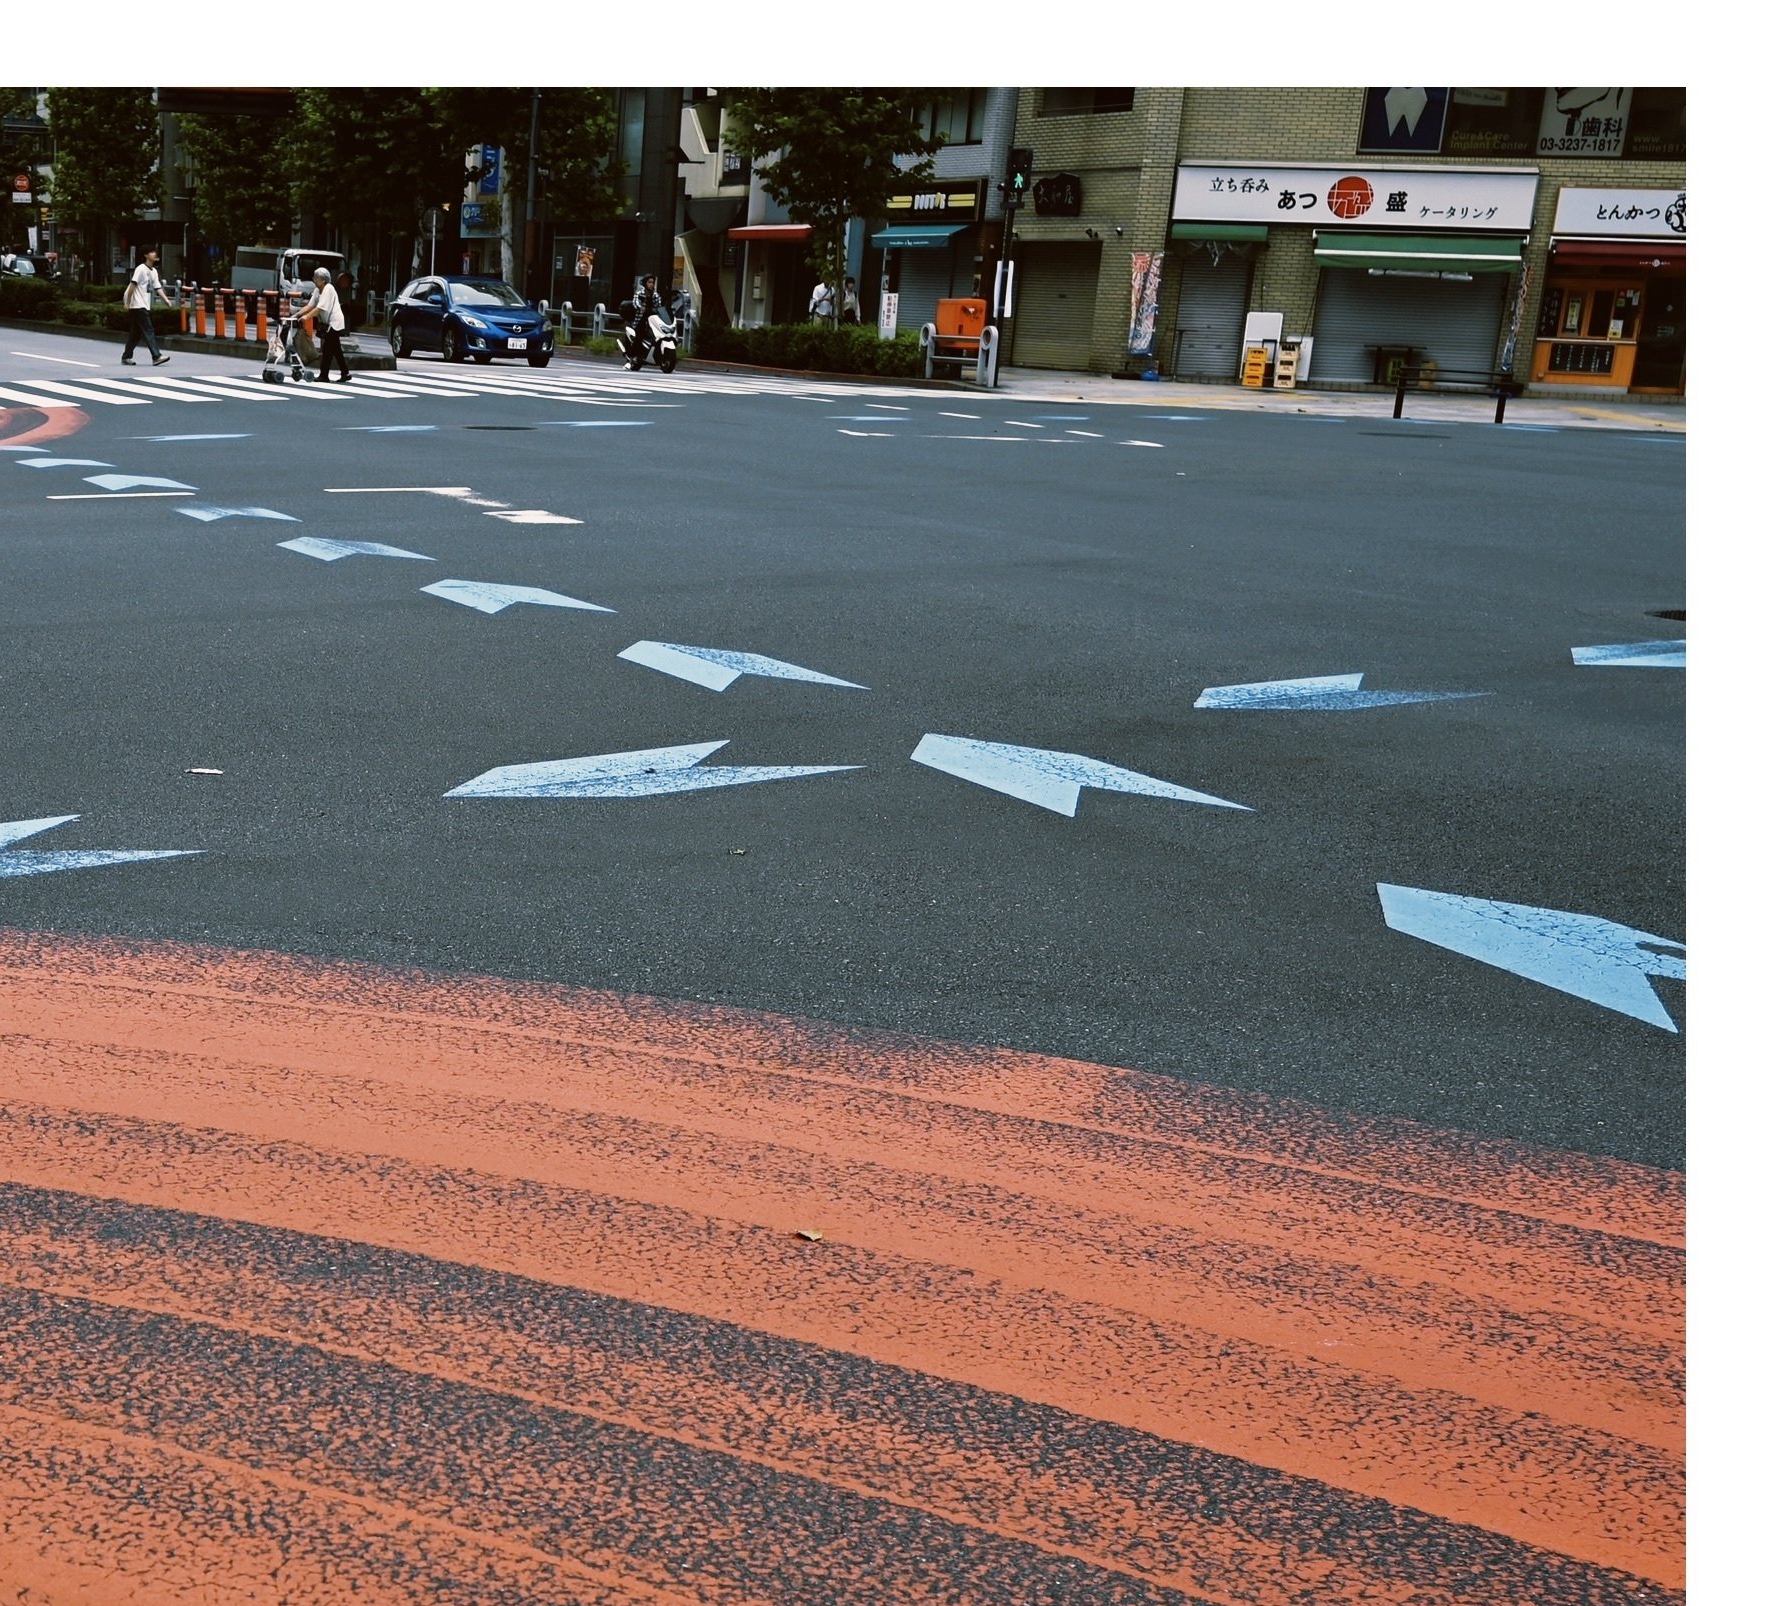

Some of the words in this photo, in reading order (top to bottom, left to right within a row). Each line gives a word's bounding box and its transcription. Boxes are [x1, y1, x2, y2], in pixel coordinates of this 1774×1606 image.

[1582, 116, 1622, 137] 歯科
[1540, 137, 1621, 151] 03-3237-1817
[1209, 177, 1269, 193] 立ち呑み
[1277, 189, 1318, 210] あつ
[1385, 190, 1408, 212] 盛
[1419, 205, 1498, 220] ケータリング
[1596, 204, 1660, 220] とんかつ
